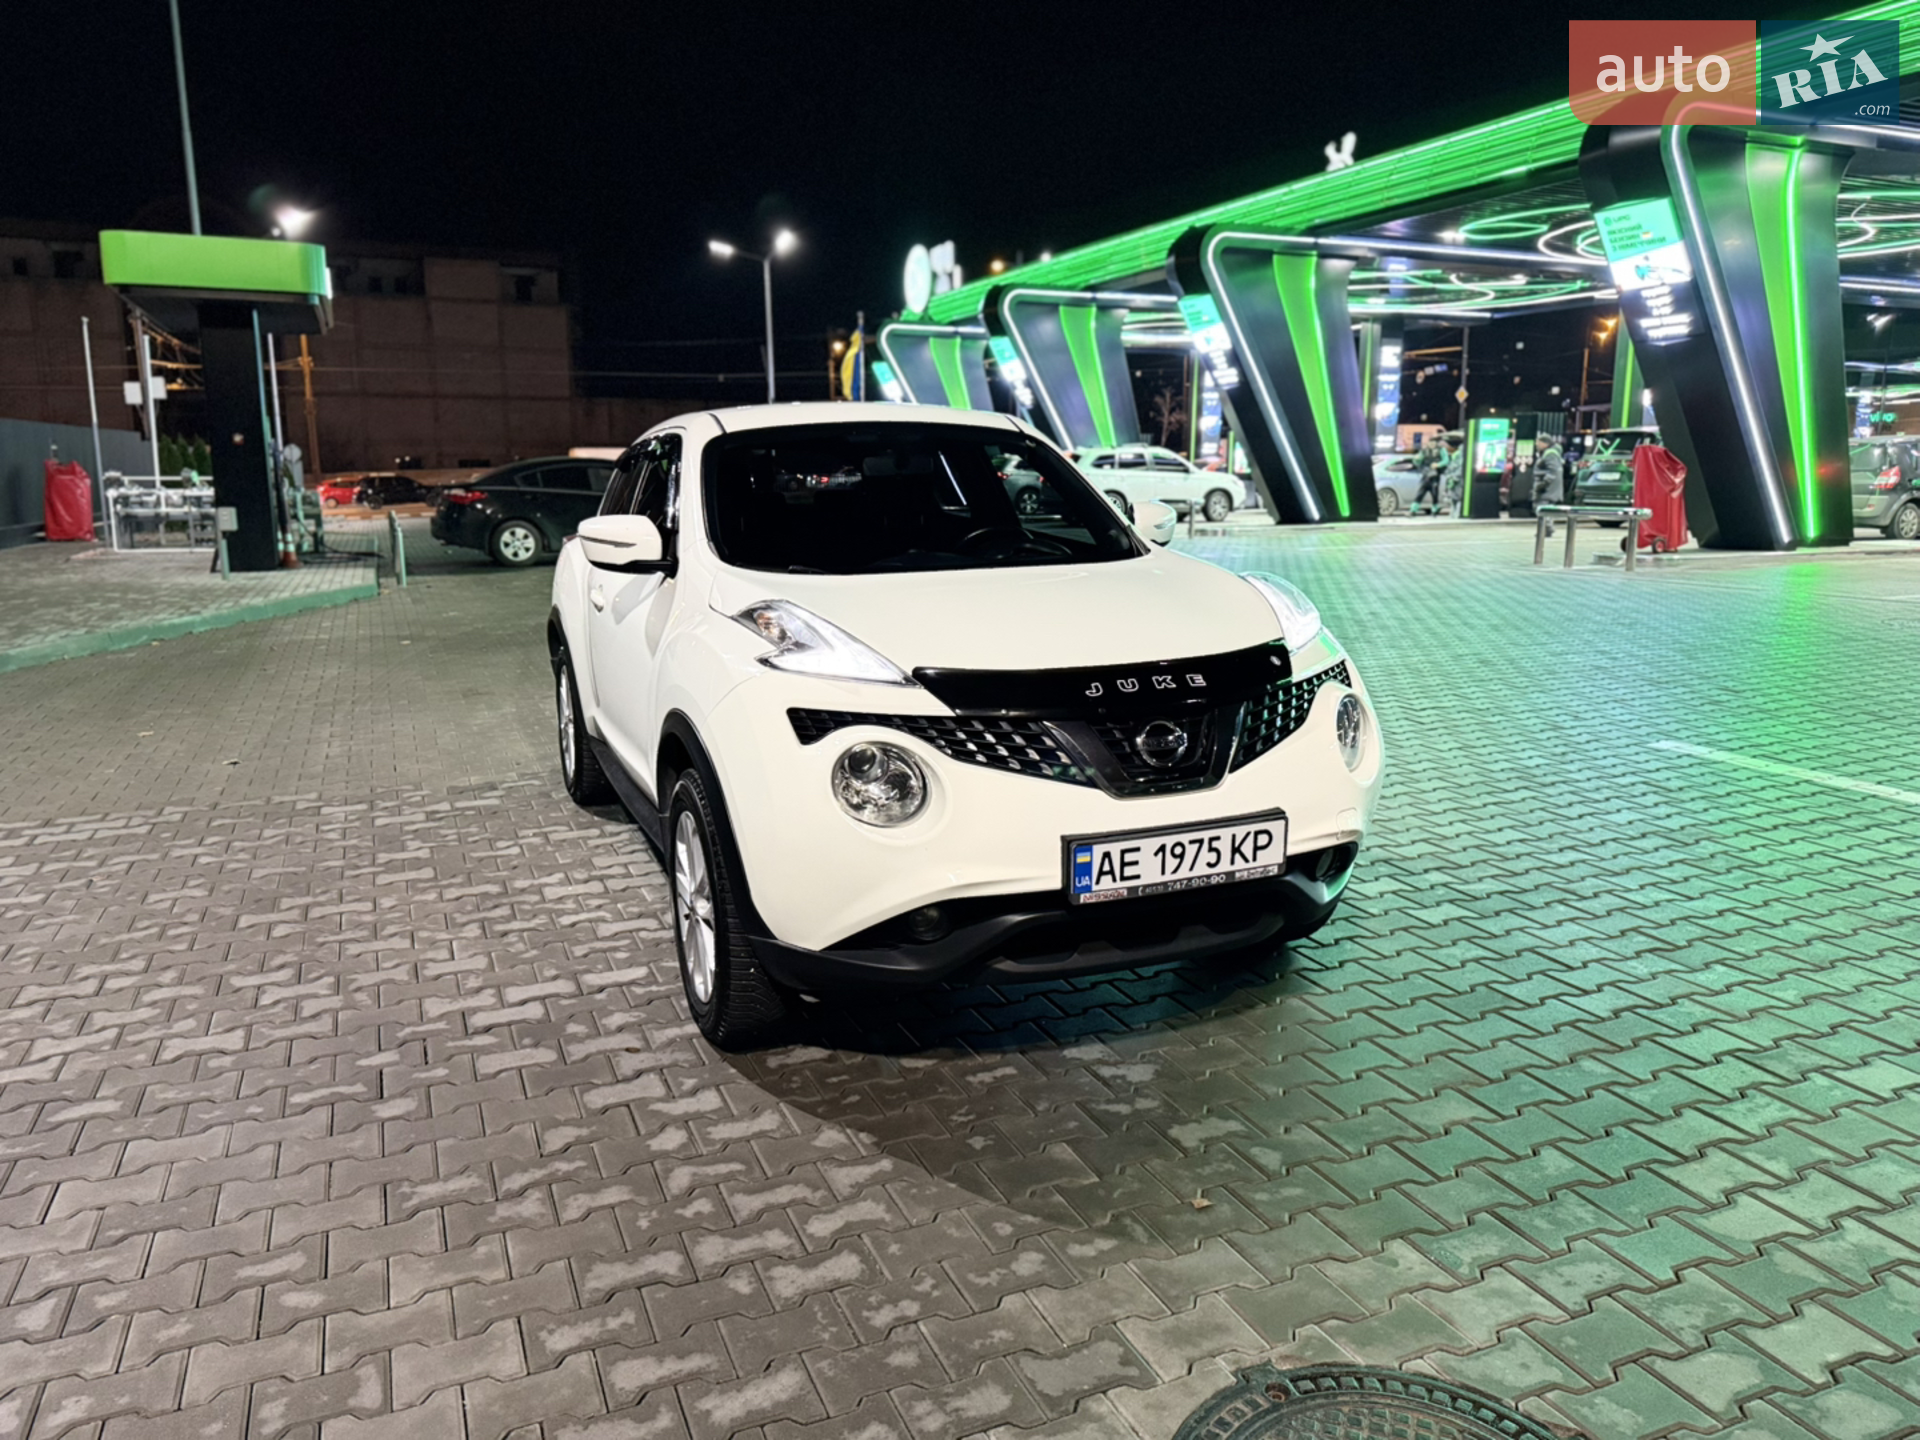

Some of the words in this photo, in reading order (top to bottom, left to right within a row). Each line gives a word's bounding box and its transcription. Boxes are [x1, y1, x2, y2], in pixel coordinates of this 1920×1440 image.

[1085, 674, 1207, 697] JUKE
[1095, 846, 1141, 886] AE
[1153, 835, 1222, 876] 1975
[1230, 829, 1273, 866] KP
[1075, 875, 1091, 888] UA
